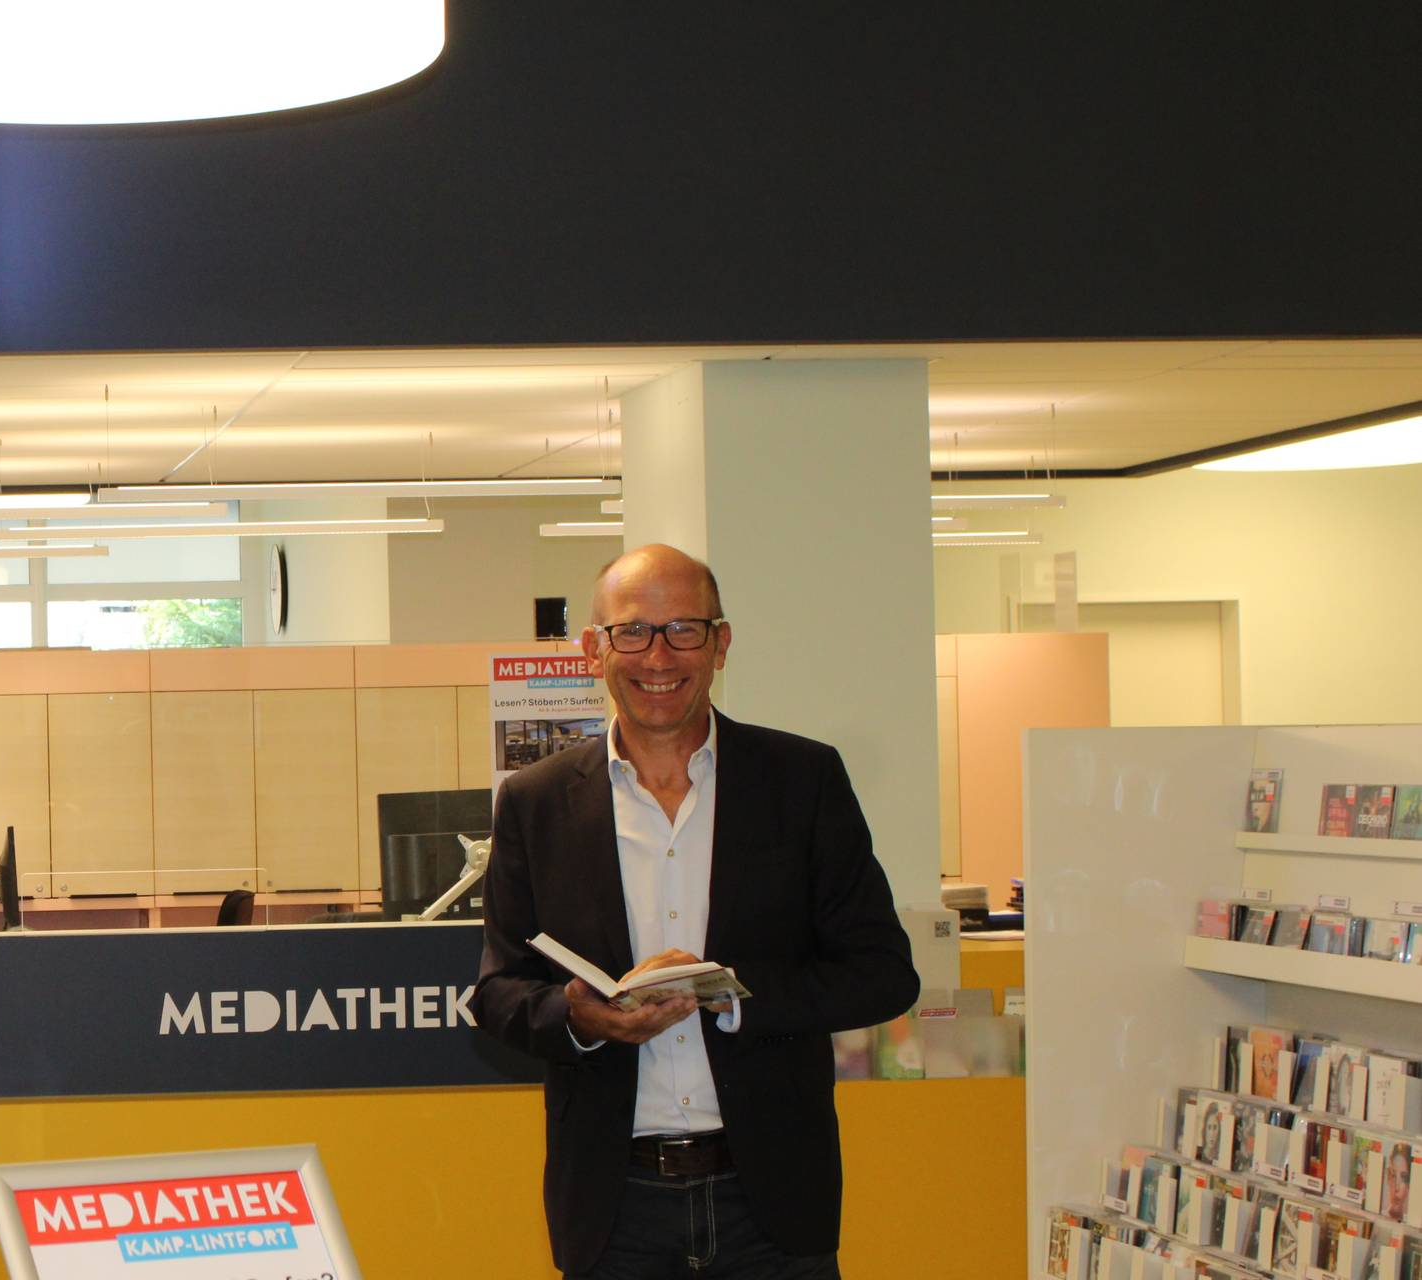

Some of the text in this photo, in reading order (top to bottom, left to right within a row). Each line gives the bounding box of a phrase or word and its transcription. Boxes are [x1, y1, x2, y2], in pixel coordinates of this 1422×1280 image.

[494, 699, 527, 708] Lesen?
[570, 696, 605, 705] Surfen?
[159, 985, 478, 1036] MEDIATHEK
[33, 1181, 298, 1233] MEDIATHEK
[125, 1227, 288, 1258] KAMP-LINTFORT
